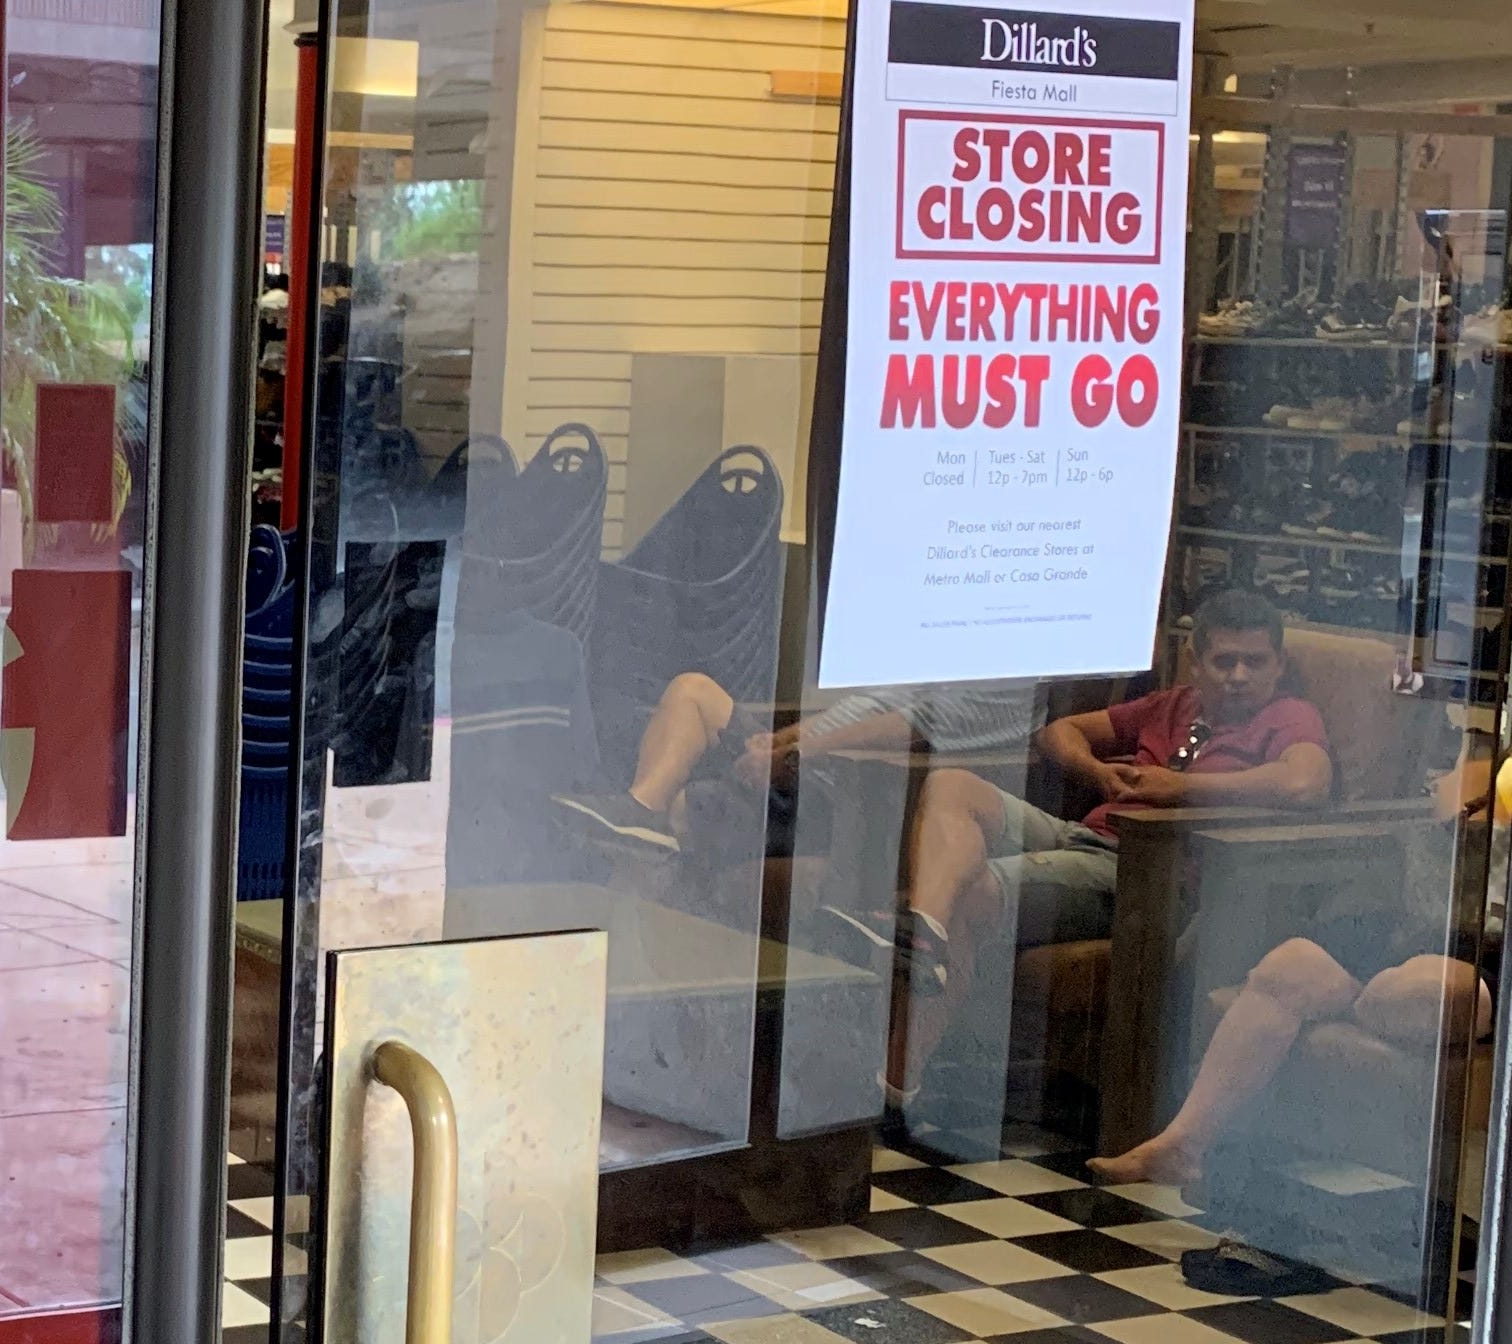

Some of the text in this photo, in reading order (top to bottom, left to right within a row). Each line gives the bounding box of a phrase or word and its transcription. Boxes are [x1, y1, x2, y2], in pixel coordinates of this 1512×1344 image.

[980, 18, 1097, 68] Dillard's
[991, 80, 1077, 103] Fiesta Mall
[952, 127, 1112, 186] STORE
[917, 185, 1142, 245] CLOSING
[889, 280, 1161, 345] EVERYTHING
[879, 352, 1159, 430] MUST GO
[936, 451, 966, 465] Mon
[988, 449, 1016, 464] Tues
[1026, 449, 1046, 464] Sat
[1066, 447, 1089, 462] Sun
[923, 471, 965, 486] Closed
[987, 470, 1010, 487] 12p
[1021, 470, 1048, 486] 7pm
[1065, 468, 1088, 484] 12p
[1098, 467, 1114, 483] 6p
[947, 519, 1082, 534] Please visit our nearest
[926, 542, 1095, 560] Dillard's Clearance Stores at
[923, 567, 1088, 586] Metro Mall or Casa Grande
